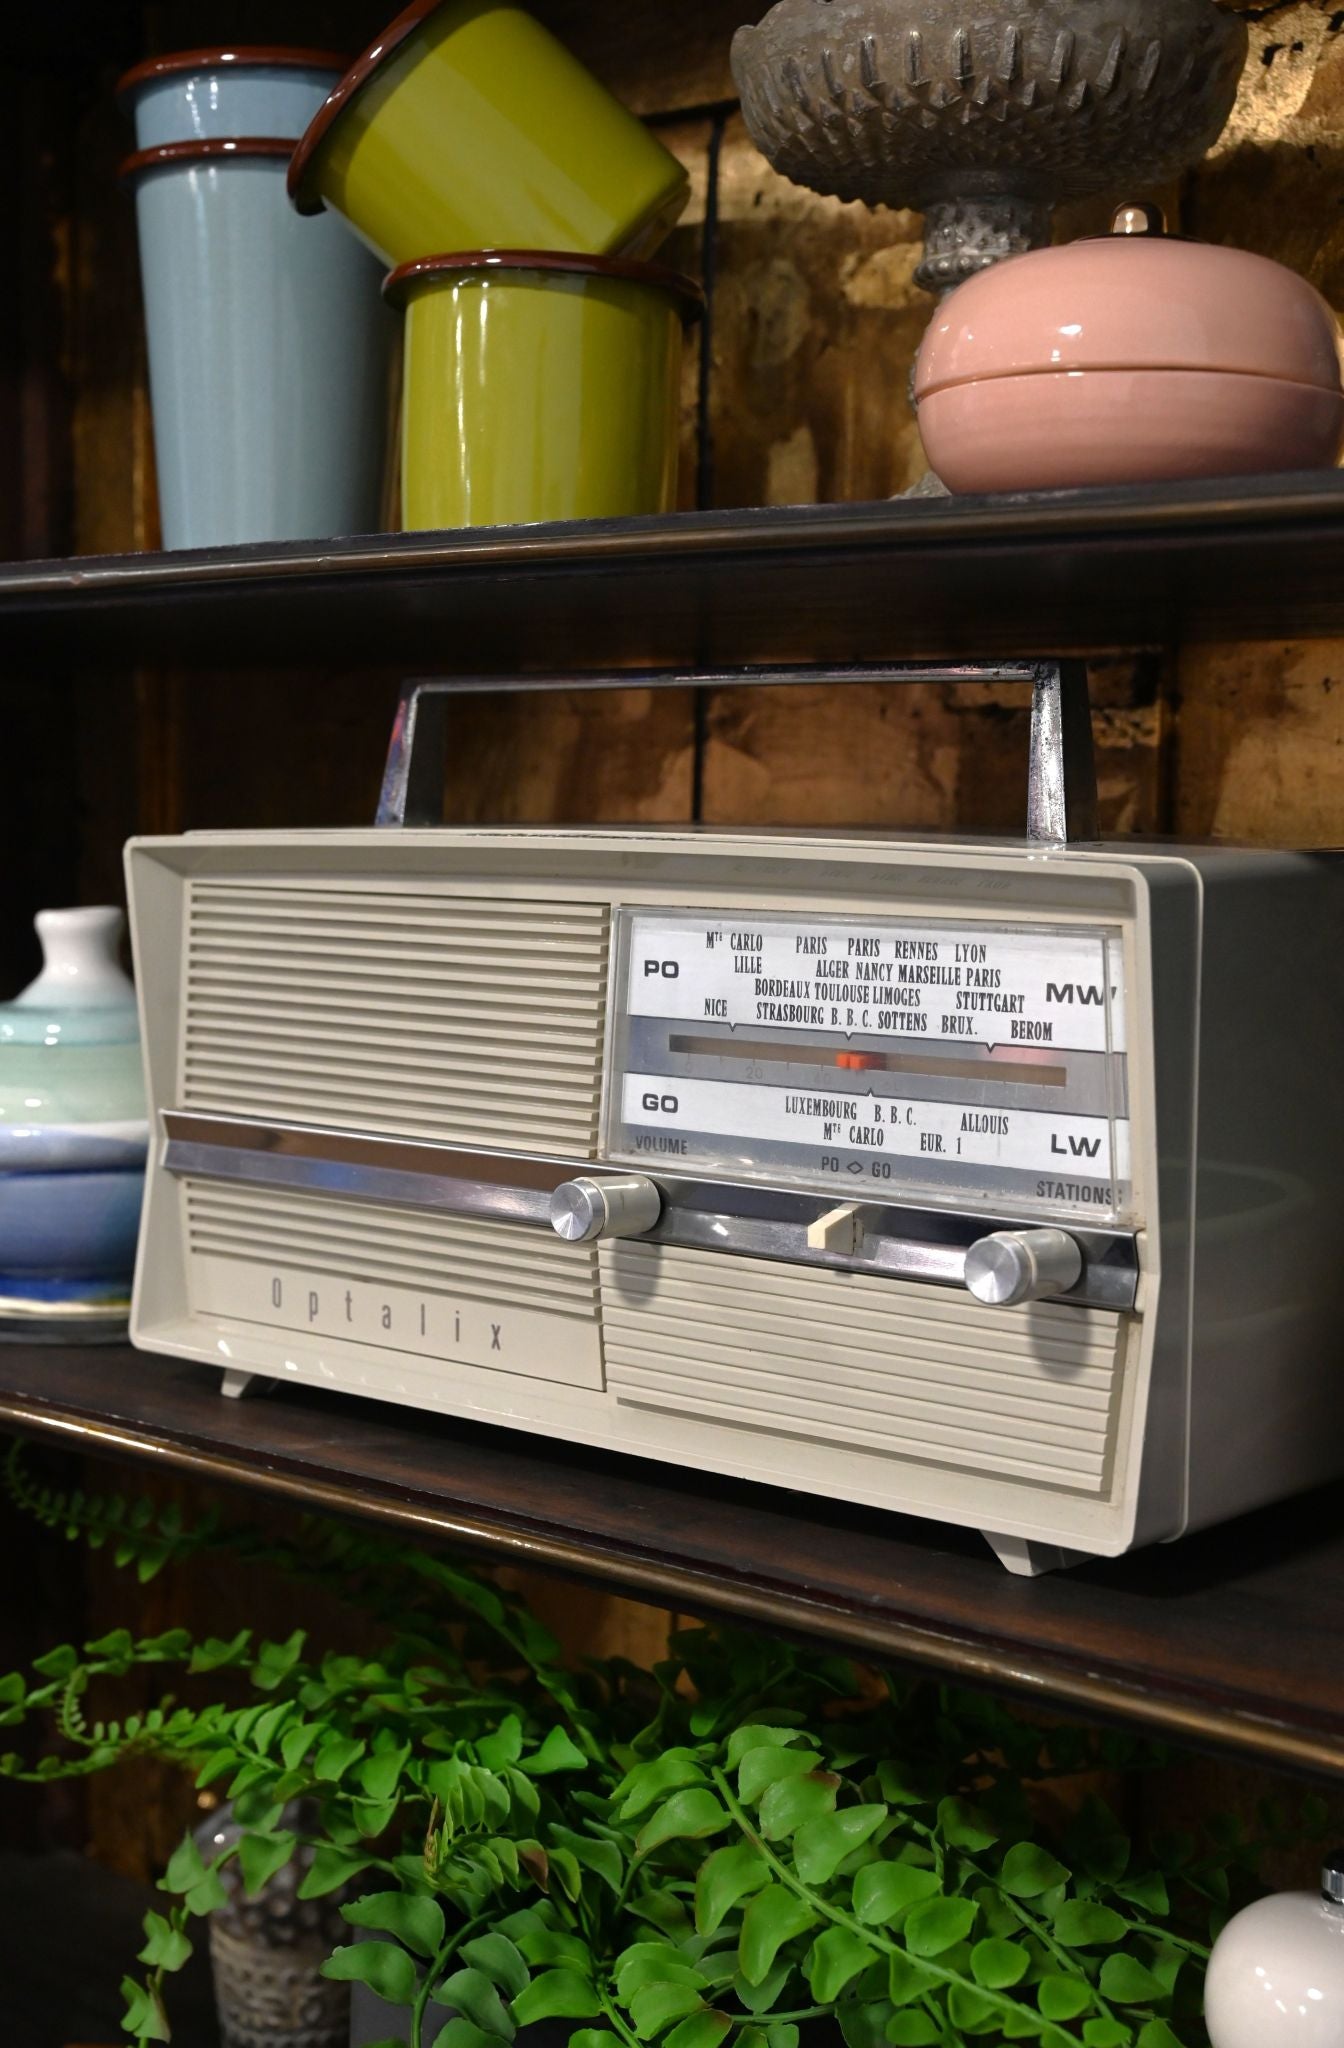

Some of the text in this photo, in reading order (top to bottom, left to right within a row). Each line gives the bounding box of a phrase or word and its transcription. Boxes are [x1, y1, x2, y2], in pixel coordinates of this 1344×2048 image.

[730, 932, 763, 952] CARLO
[796, 936, 827, 955] PARIS
[848, 938, 880, 957] PARIS
[894, 940, 938, 961] RENNES
[955, 943, 987, 963] LYON
[644, 960, 680, 979] PO
[734, 955, 1001, 988] LILLE ALGER NANCY MARSEILLE PARIS
[754, 978, 1025, 1014] BORDEAUX TOULOUSE LIMOGES STUTTGART
[1046, 983, 1117, 1006] MW
[704, 998, 728, 1017] NICE
[756, 1002, 824, 1025] STRASBOURG
[877, 1011, 927, 1032] SOTTENS
[941, 1015, 978, 1035] BRUX.
[1010, 1019, 1053, 1041] BEROM
[745, 1066, 763, 1080] 20
[642, 1093, 679, 1114] GO
[785, 1095, 857, 1120] LUXEMBOURG
[960, 1113, 1009, 1135] ALLOUIS
[635, 1135, 688, 1155] VOLUME
[849, 1125, 884, 1147] CARLO
[920, 1132, 946, 1153] EUR.
[956, 1137, 962, 1155] 1
[1050, 1134, 1102, 1158] LW
[821, 1156, 891, 1179] PO GO
[1036, 1180, 1113, 1206] STATIONS
